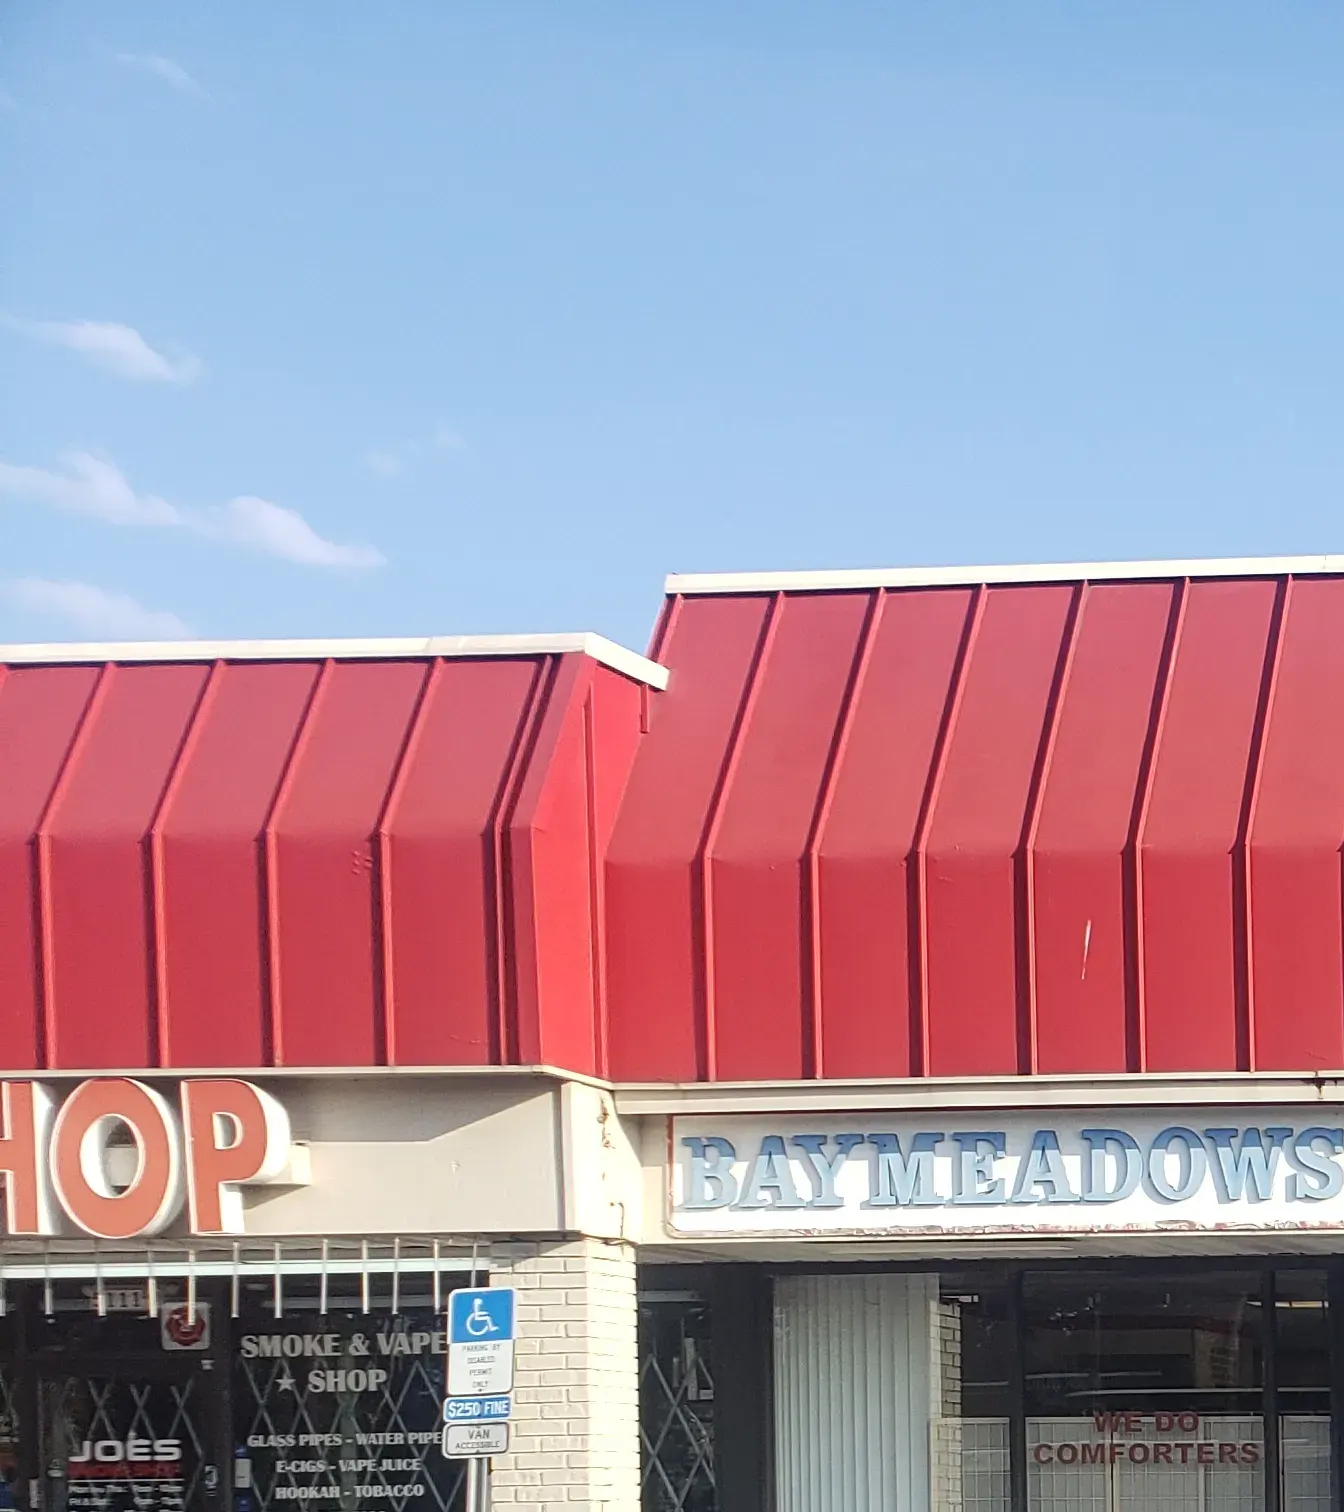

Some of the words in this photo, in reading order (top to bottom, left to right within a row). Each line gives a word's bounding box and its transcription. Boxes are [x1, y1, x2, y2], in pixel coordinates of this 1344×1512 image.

[681, 1126, 1344, 1211] BAYMEADOWS
[240, 1334, 342, 1358] SMOKE
[348, 1333, 371, 1356] &
[376, 1332, 447, 1355] VAPE
[307, 1369, 387, 1393] SHOP
[448, 1401, 480, 1418] $250
[484, 1400, 509, 1415] FINE
[1093, 1411, 1143, 1433] WE
[1155, 1411, 1199, 1432] DO
[247, 1434, 295, 1447] GLASS
[298, 1433, 342, 1446] PIPES
[356, 1432, 404, 1445] WATER
[407, 1432, 442, 1445] PIPE
[467, 1429, 490, 1440] VAN
[455, 1440, 501, 1450] ACCESSIBLE
[1033, 1442, 1260, 1464] COMFORTERS
[276, 1460, 328, 1473] E-CIGS
[338, 1459, 377, 1472] VAPE
[378, 1458, 422, 1471] JUICE
[275, 1486, 341, 1500] HOOKAH
[353, 1484, 425, 1498] TOBACCO
